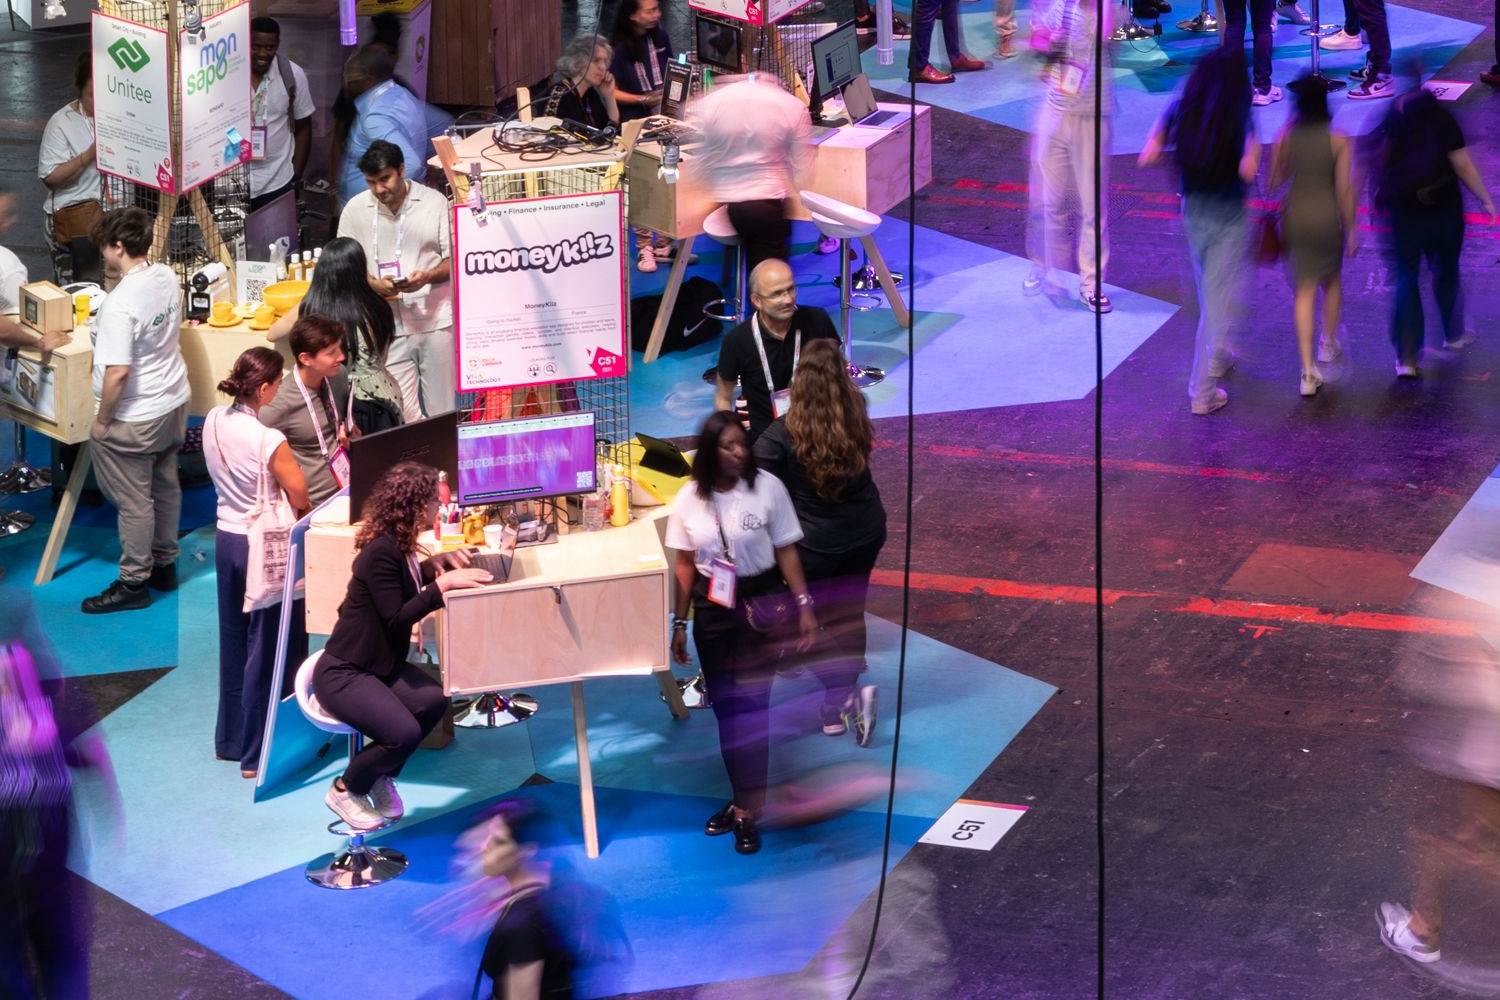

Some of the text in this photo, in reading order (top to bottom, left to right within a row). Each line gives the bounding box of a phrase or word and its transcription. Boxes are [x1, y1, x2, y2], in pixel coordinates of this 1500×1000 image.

[107, 74, 152, 104] Unitee
[508, 205, 537, 216] Finance
[543, 201, 579, 212] Insurance
[585, 200, 606, 208] Legal
[597, 355, 617, 366] C51
[951, 820, 986, 841] C51
